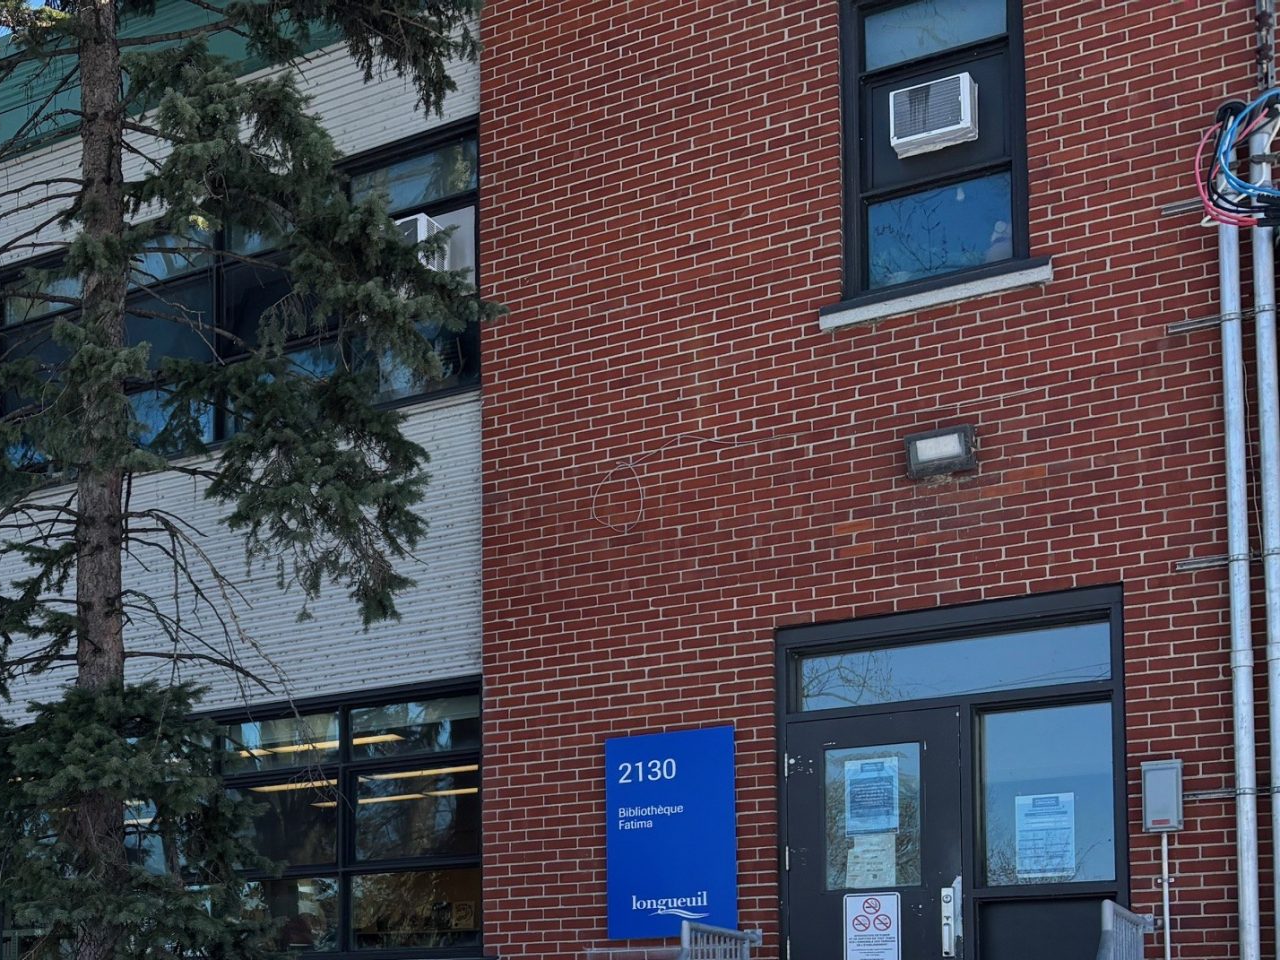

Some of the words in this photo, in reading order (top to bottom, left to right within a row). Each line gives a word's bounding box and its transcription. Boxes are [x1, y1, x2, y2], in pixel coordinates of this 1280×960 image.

[618, 758, 677, 784] 2130
[618, 805, 684, 818] Bibliothèque
[618, 819, 653, 831] Fatima
[632, 891, 708, 914] longueuil
